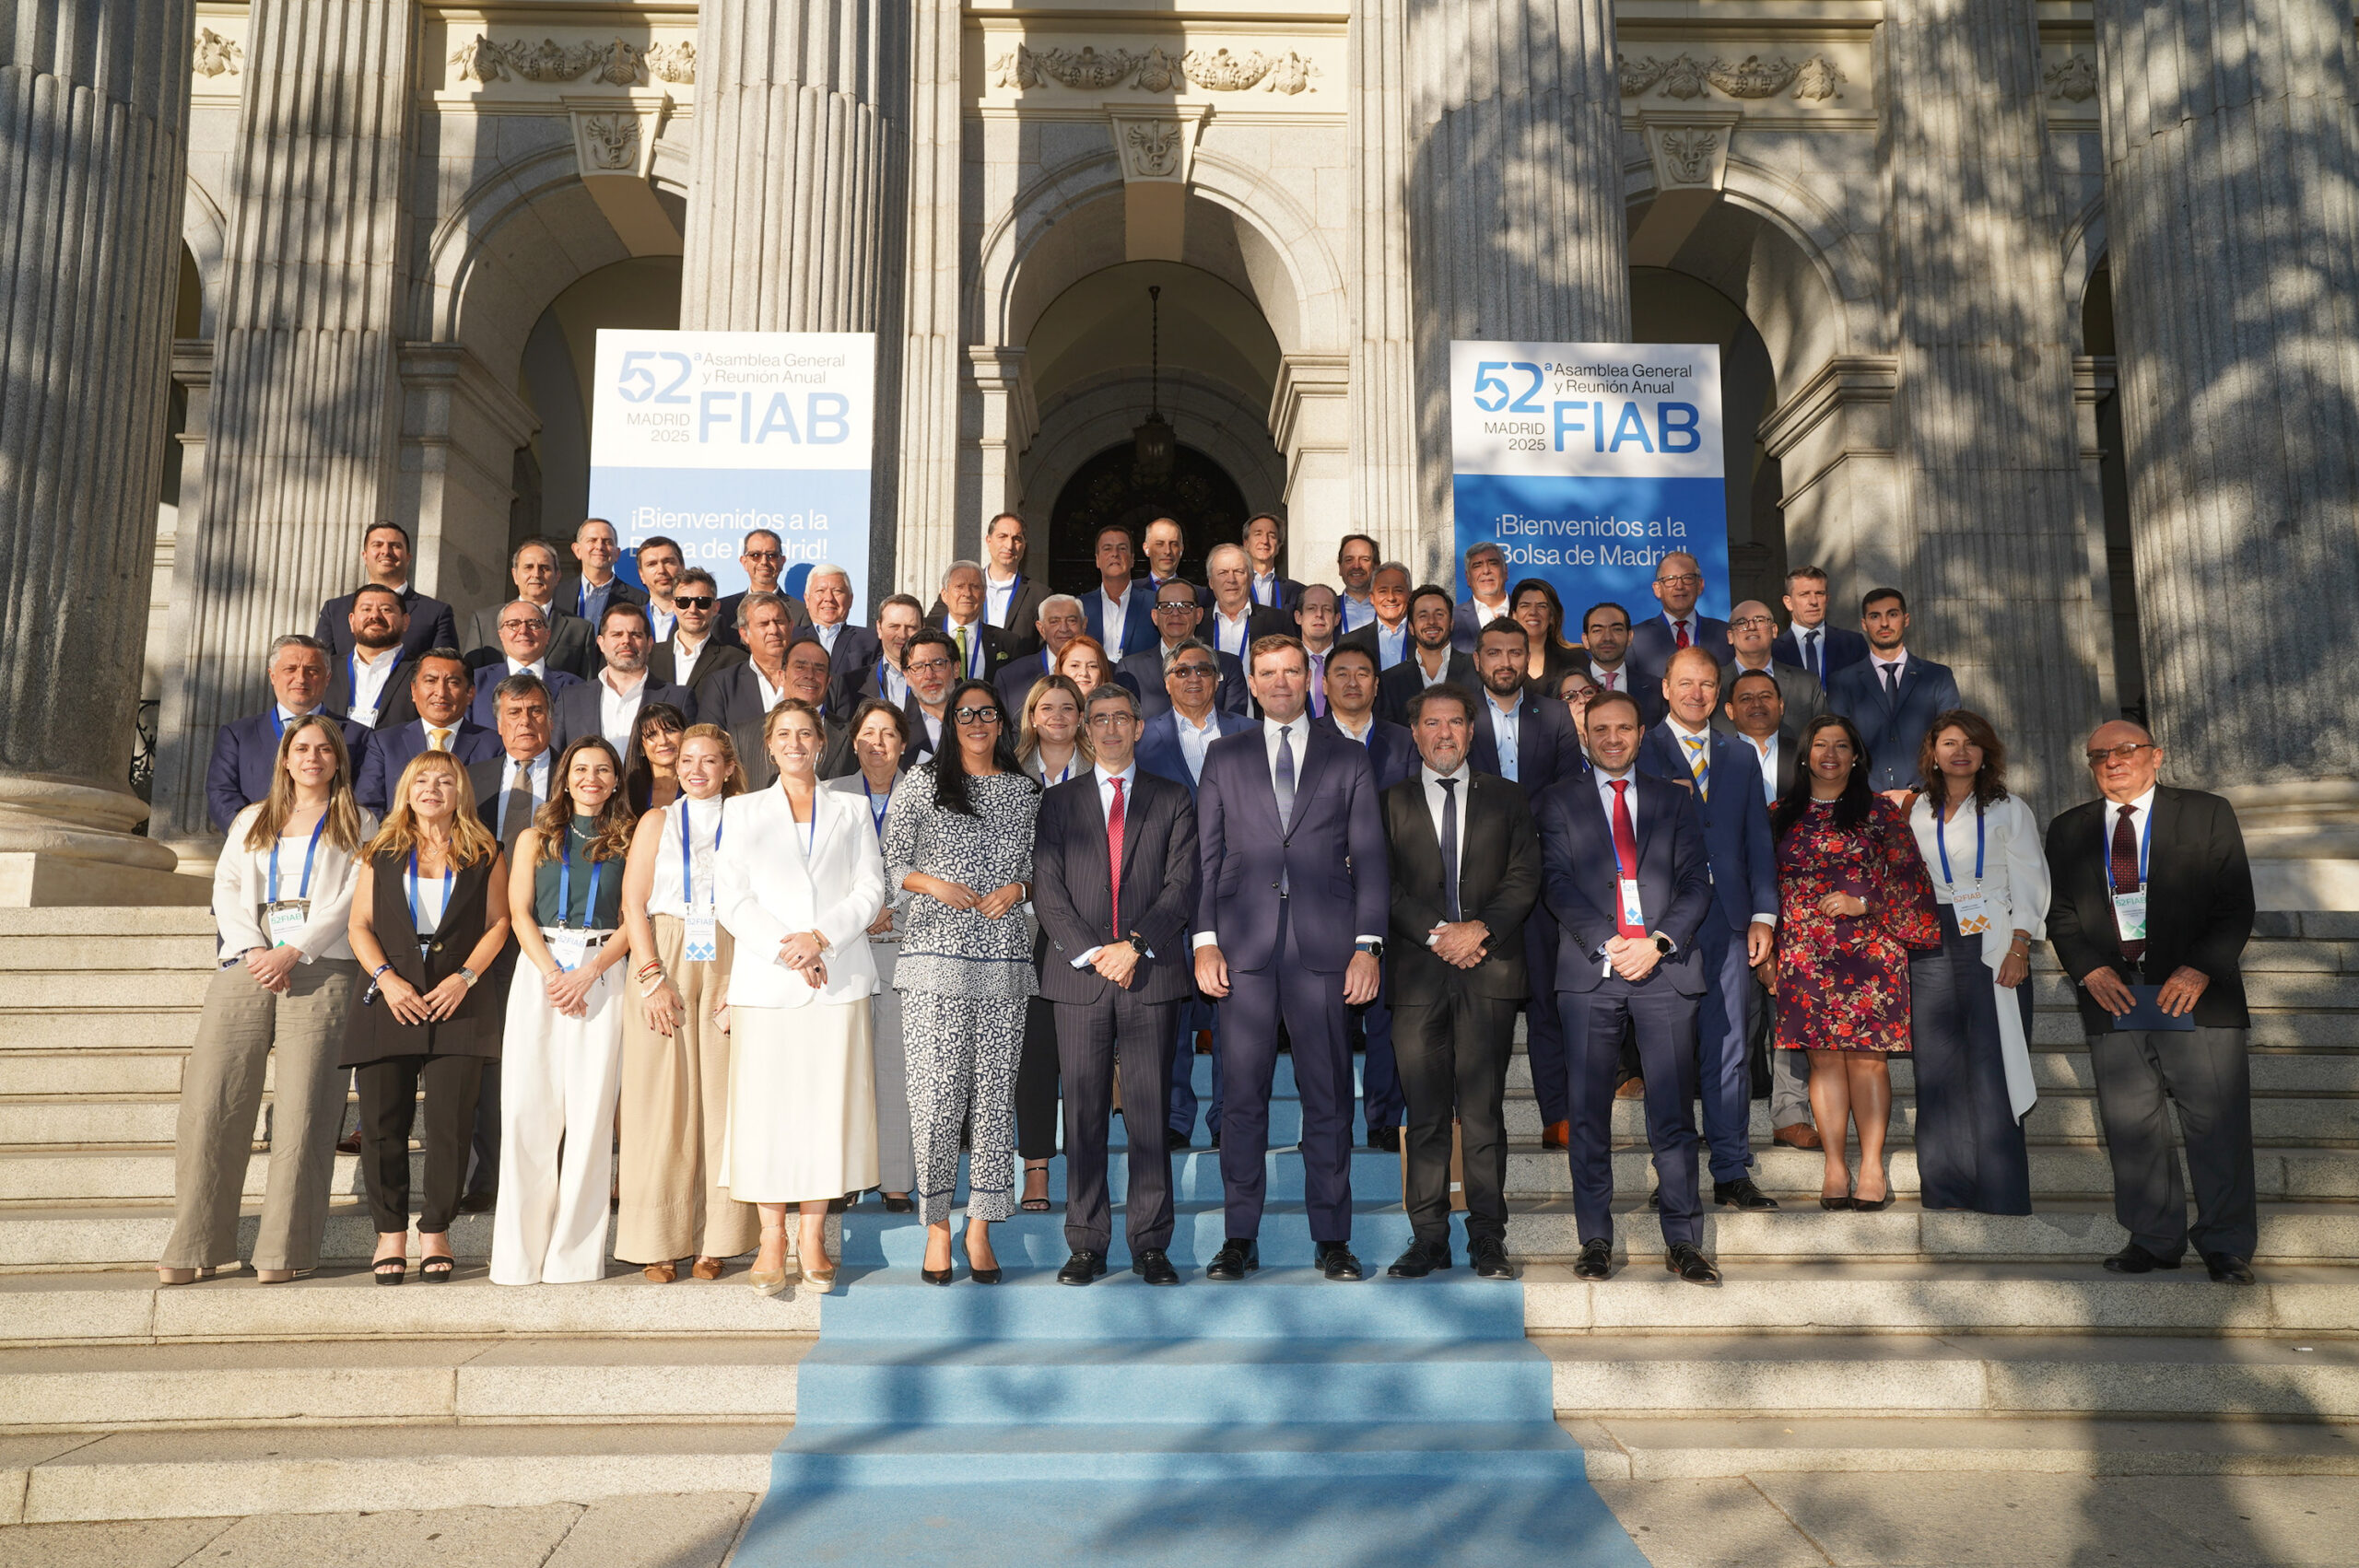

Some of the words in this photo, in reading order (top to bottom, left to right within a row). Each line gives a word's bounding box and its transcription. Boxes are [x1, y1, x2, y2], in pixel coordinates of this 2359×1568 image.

[703, 352, 780, 367] Asamblea
[783, 353, 845, 368] General
[702, 371, 712, 385] y
[715, 369, 779, 383] Reunión
[781, 369, 827, 384] Anual
[1555, 362, 1629, 377] Asamblea
[1632, 363, 1692, 378] General
[1555, 381, 1563, 395] y
[1567, 379, 1628, 394] Reunión
[1631, 380, 1674, 394] Anual
[627, 413, 691, 427] MADRID
[698, 391, 851, 444] FIAB
[651, 428, 691, 442] 2025
[1485, 422, 1545, 435] MADRID
[1554, 401, 1701, 453] FIAB
[1508, 438, 1546, 451] 2025
[631, 507, 785, 532] ¡Bienvenidos
[789, 512, 804, 531] a
[809, 509, 828, 531] la
[1496, 514, 1644, 538] ¡Bienvenidos
[1648, 521, 1662, 537] a
[1667, 516, 1687, 537] la
[701, 537, 733, 559] de
[1565, 544, 1595, 566] de
[1600, 544, 1687, 567] Madri
